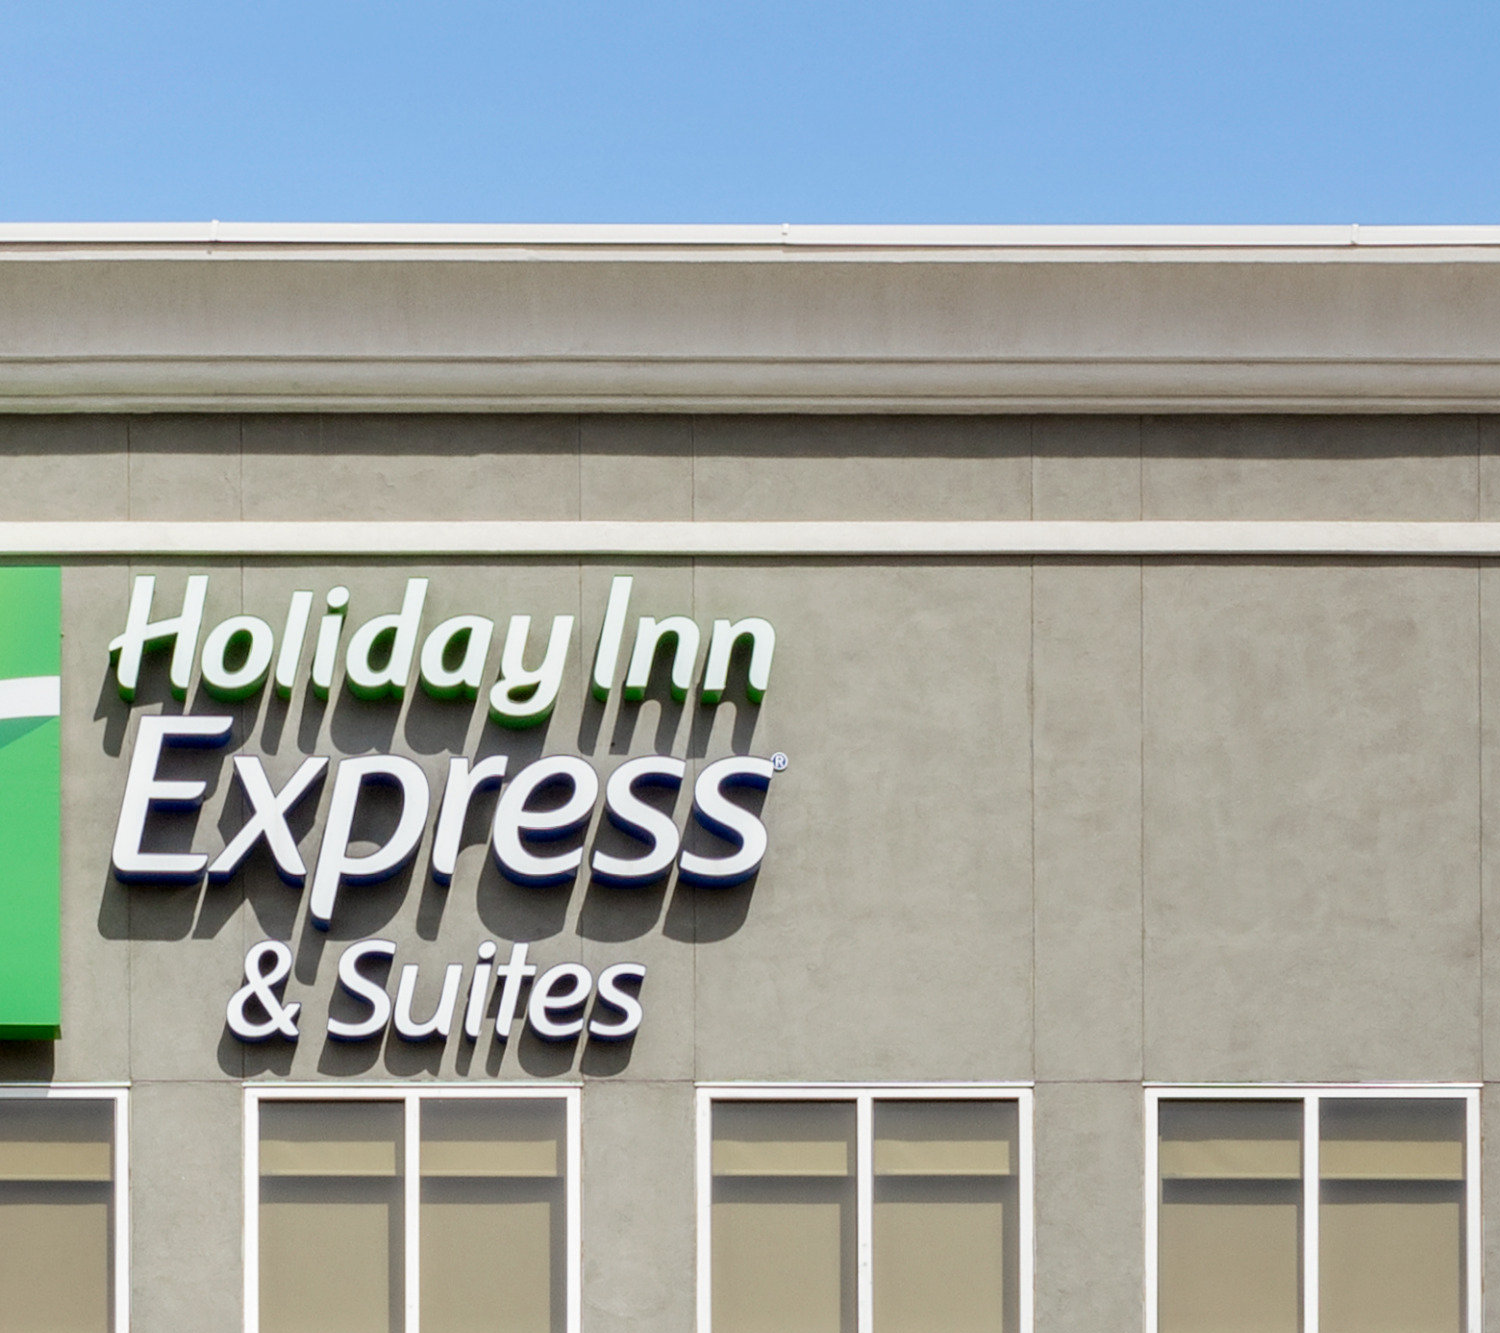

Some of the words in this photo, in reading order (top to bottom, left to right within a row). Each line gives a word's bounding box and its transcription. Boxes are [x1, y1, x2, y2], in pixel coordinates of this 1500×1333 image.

[107, 574, 575, 724] Holiday
[592, 574, 777, 698] Inn
[226, 938, 301, 1039] &
[326, 938, 648, 1039] Suites
